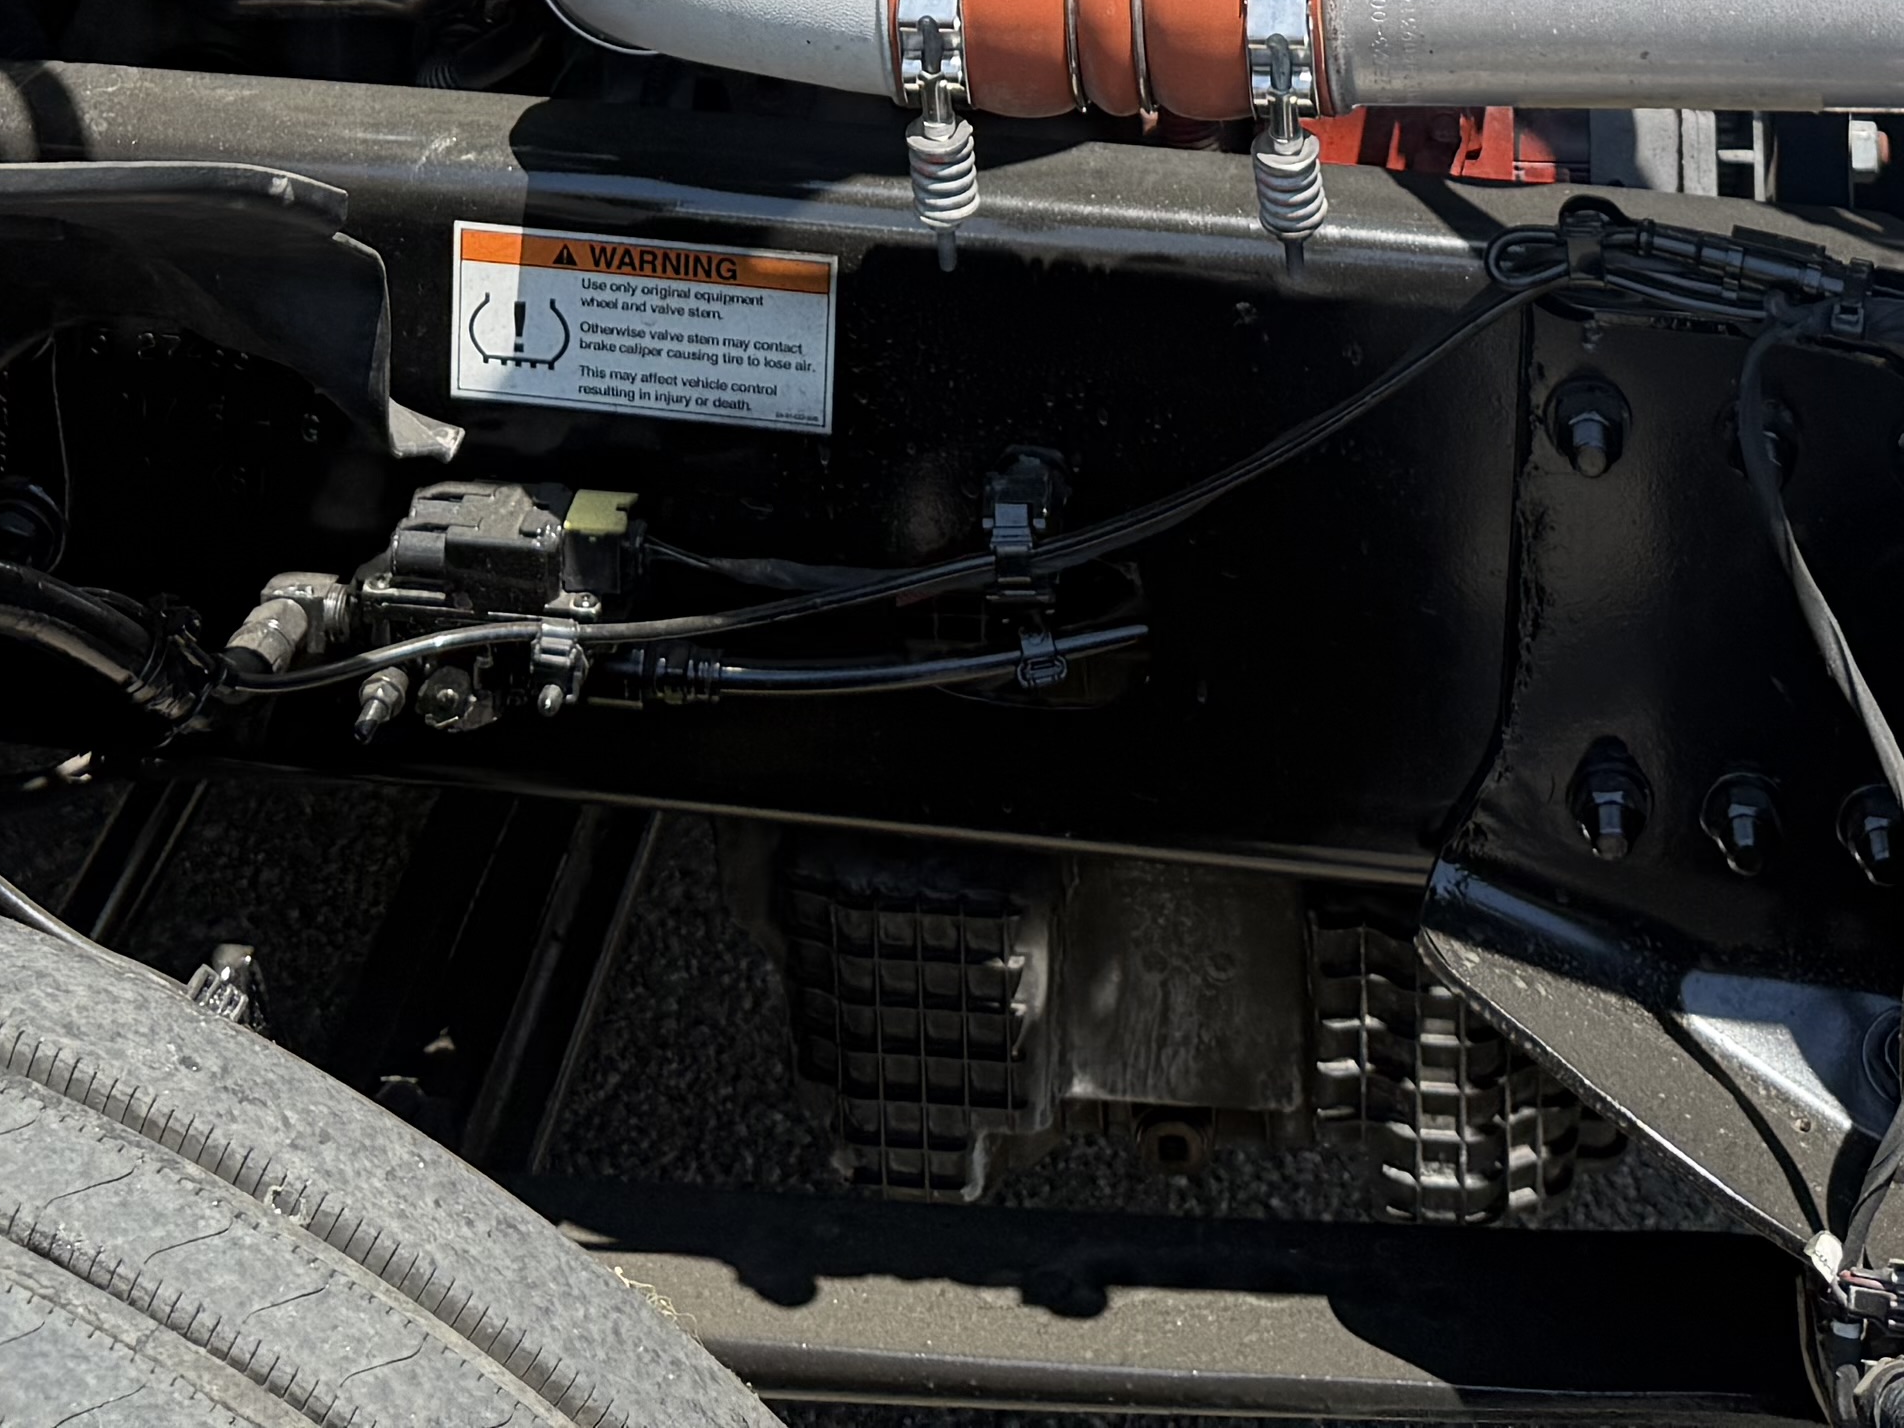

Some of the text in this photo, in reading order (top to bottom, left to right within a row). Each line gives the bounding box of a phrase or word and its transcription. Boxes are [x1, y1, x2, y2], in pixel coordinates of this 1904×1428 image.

[589, 243, 738, 282] WARNING
[580, 277, 764, 307] Use only original equipment
[580, 296, 724, 321] wheel and valve stem.
[579, 320, 804, 355] Otherwise valve stem may contact
[578, 337, 817, 373] brake caliper causing tire to lose air.
[578, 364, 778, 396] This may affect vehicle control
[578, 384, 752, 412] resulting in injury or death.
